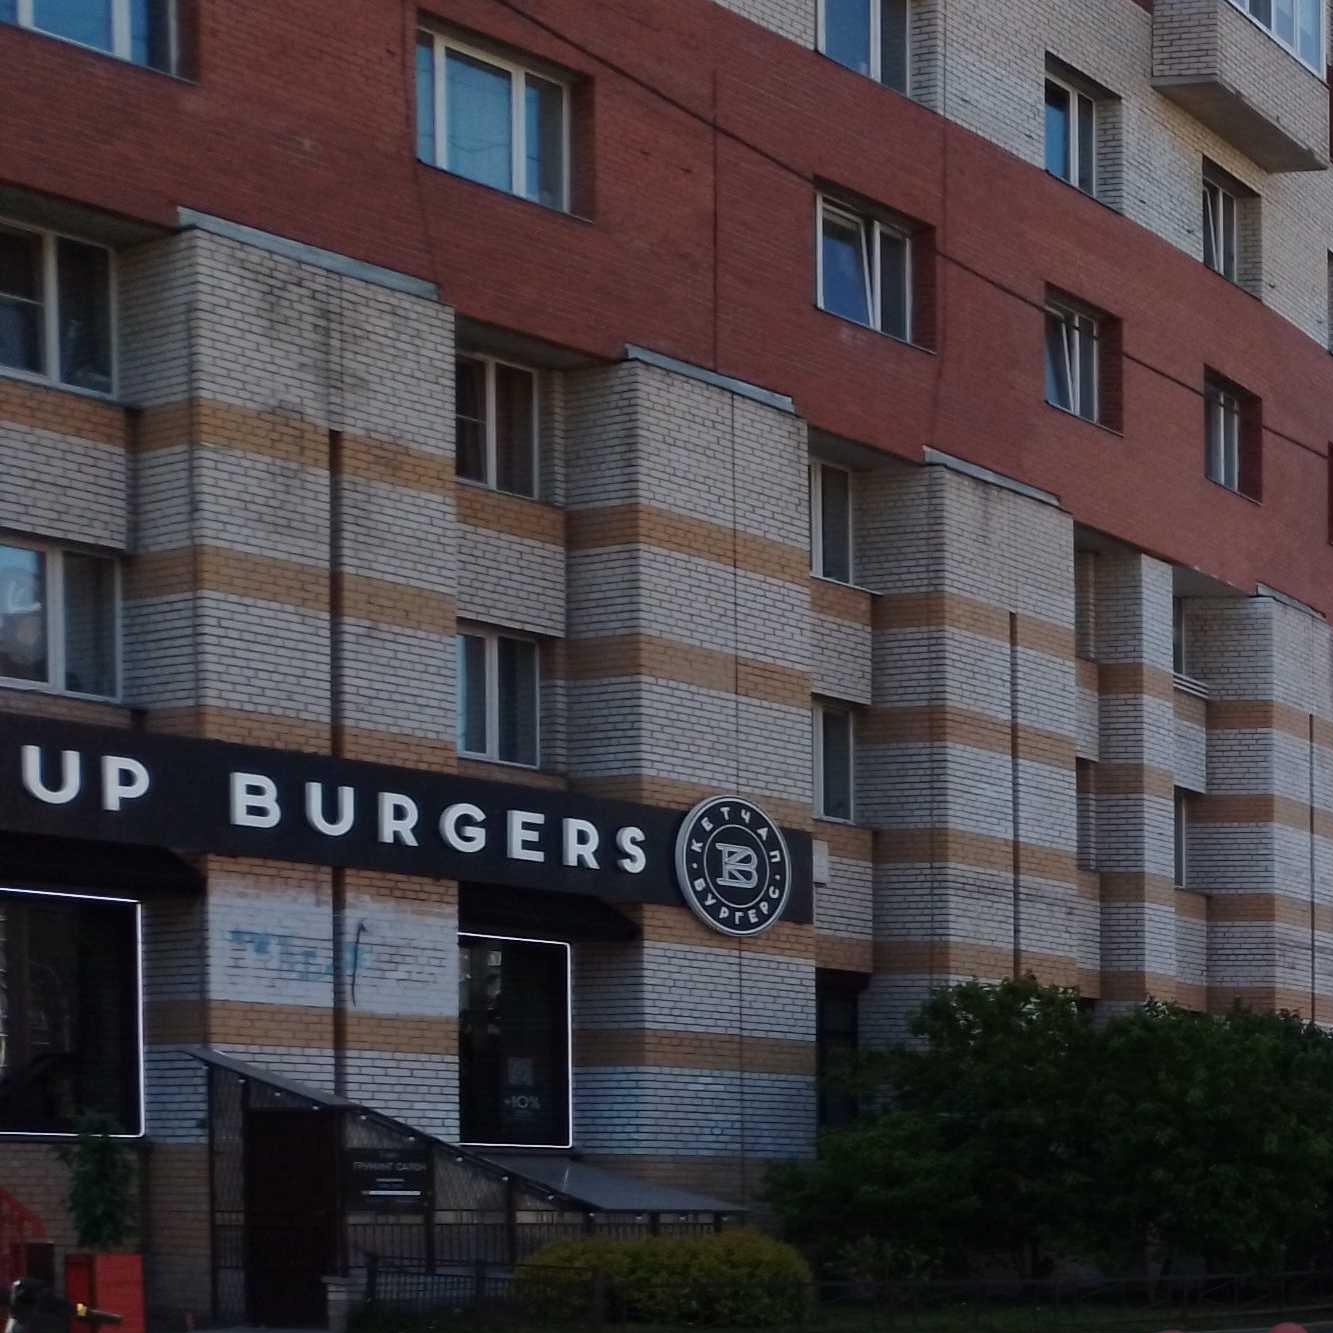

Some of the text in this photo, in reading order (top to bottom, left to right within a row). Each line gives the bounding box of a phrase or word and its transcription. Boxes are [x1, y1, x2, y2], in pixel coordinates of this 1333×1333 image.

[21, 744, 647, 875] UP BURGERS
[690, 806, 781, 862] КЕТЧАП
[693, 878, 780, 925] БУРГЕРС
